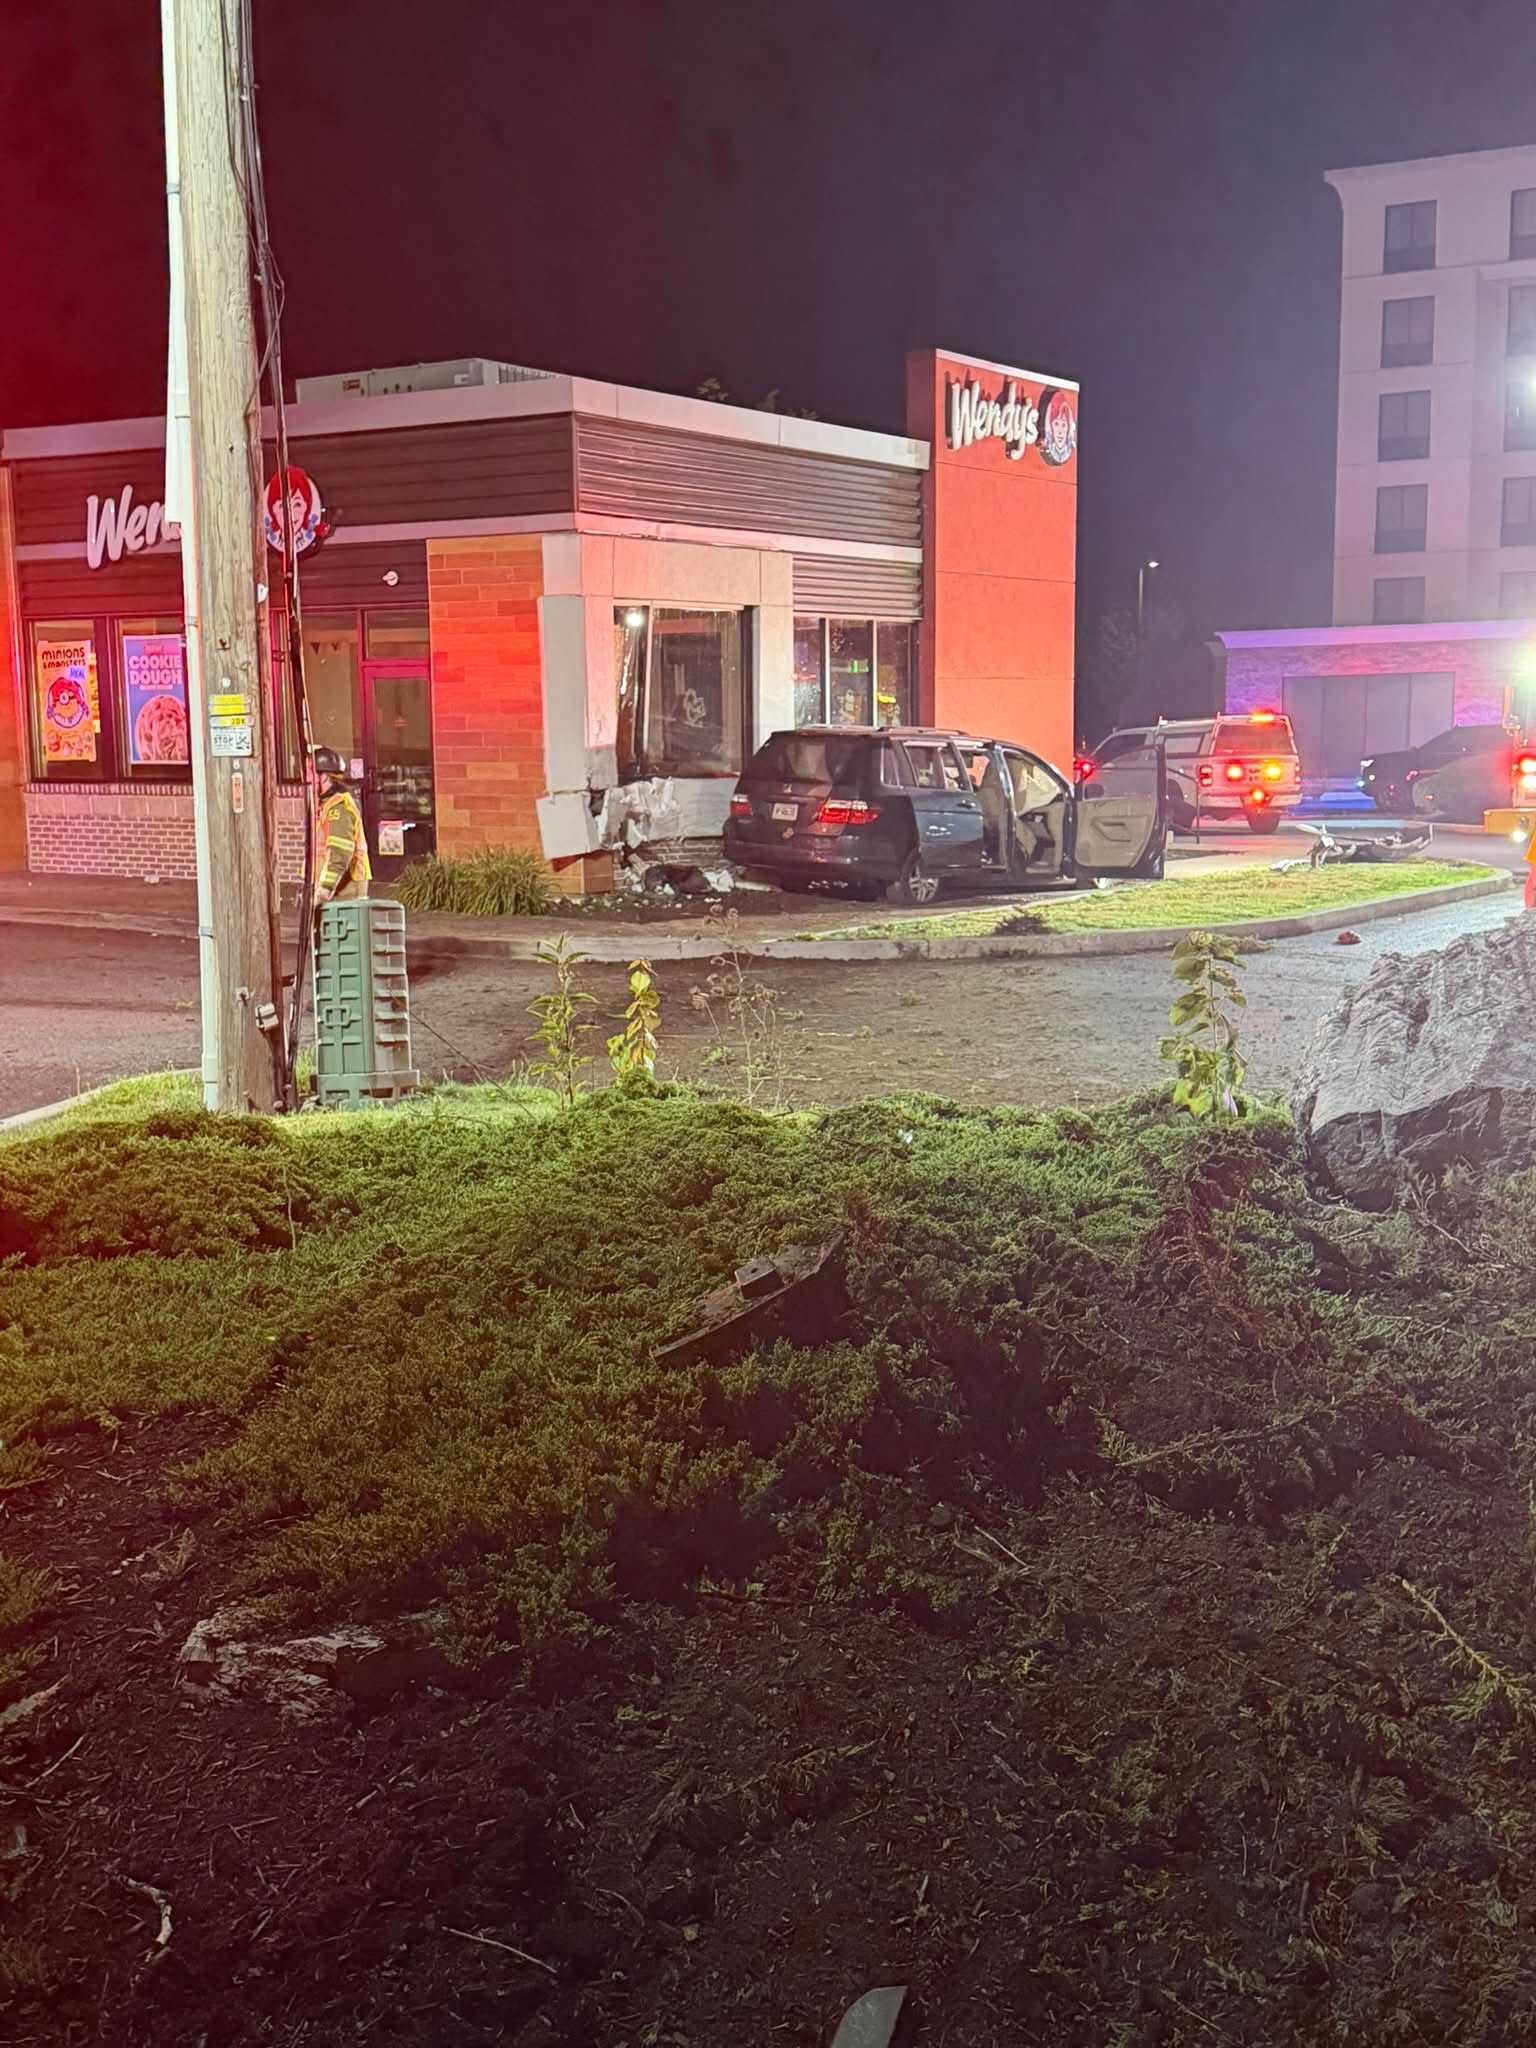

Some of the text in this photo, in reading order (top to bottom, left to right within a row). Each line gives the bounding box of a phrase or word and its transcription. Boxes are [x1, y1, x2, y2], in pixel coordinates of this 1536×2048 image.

[42, 647, 85, 661] minions
[129, 655, 182, 669] COOKIE
[130, 670, 183, 685] DOUGH
